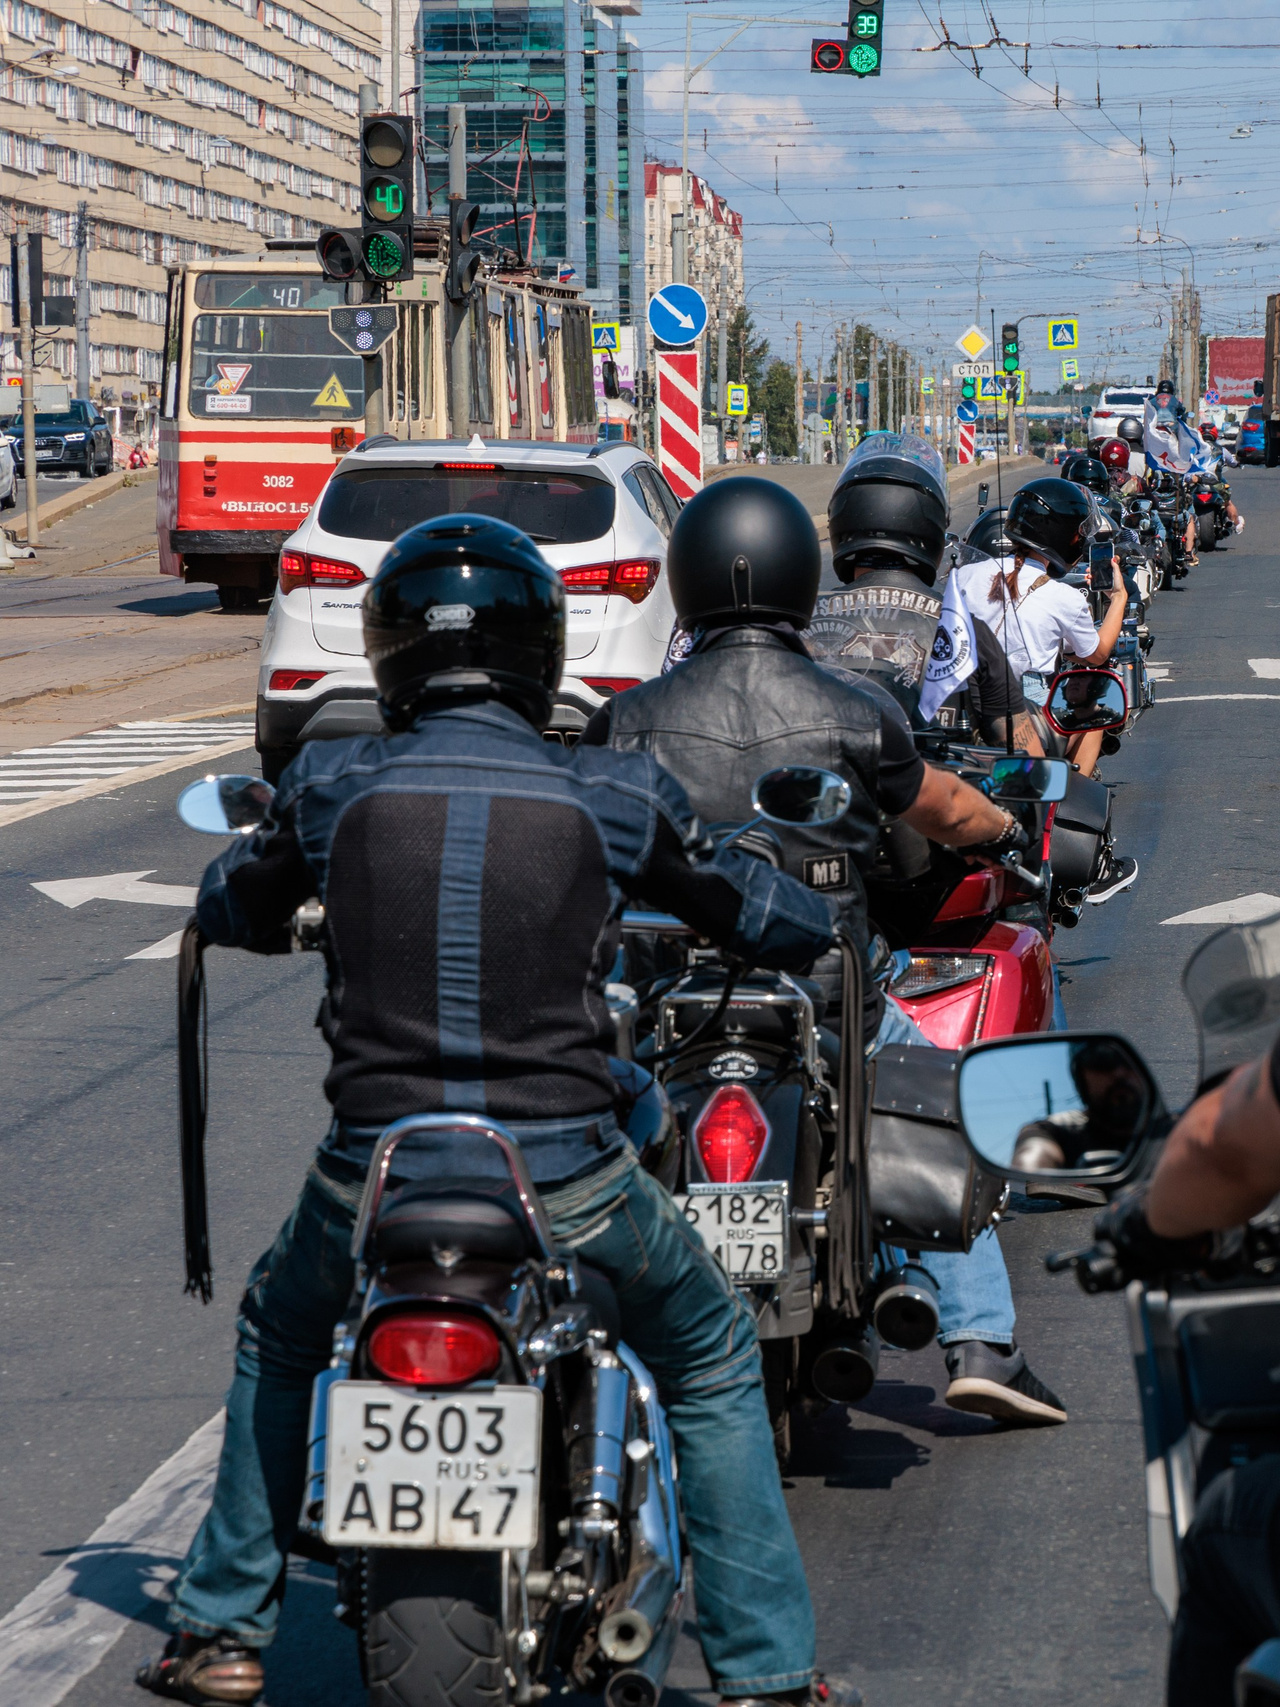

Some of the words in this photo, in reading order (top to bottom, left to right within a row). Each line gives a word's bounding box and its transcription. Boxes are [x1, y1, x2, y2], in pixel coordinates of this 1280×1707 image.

[858, 16, 876, 34] 39
[376, 184, 402, 213] 40
[273, 287, 300, 308] 40
[958, 364, 990, 375] СТОП
[262, 475, 294, 488] 3082
[226, 501, 286, 513] ВЫНОС
[812, 859, 840, 885] MC
[727, 1229, 755, 1240] RUS
[737, 1244, 777, 1272] 78
[363, 1401, 504, 1456] 5603
[437, 1459, 489, 1481] RUS
[452, 1483, 519, 1536] 47
